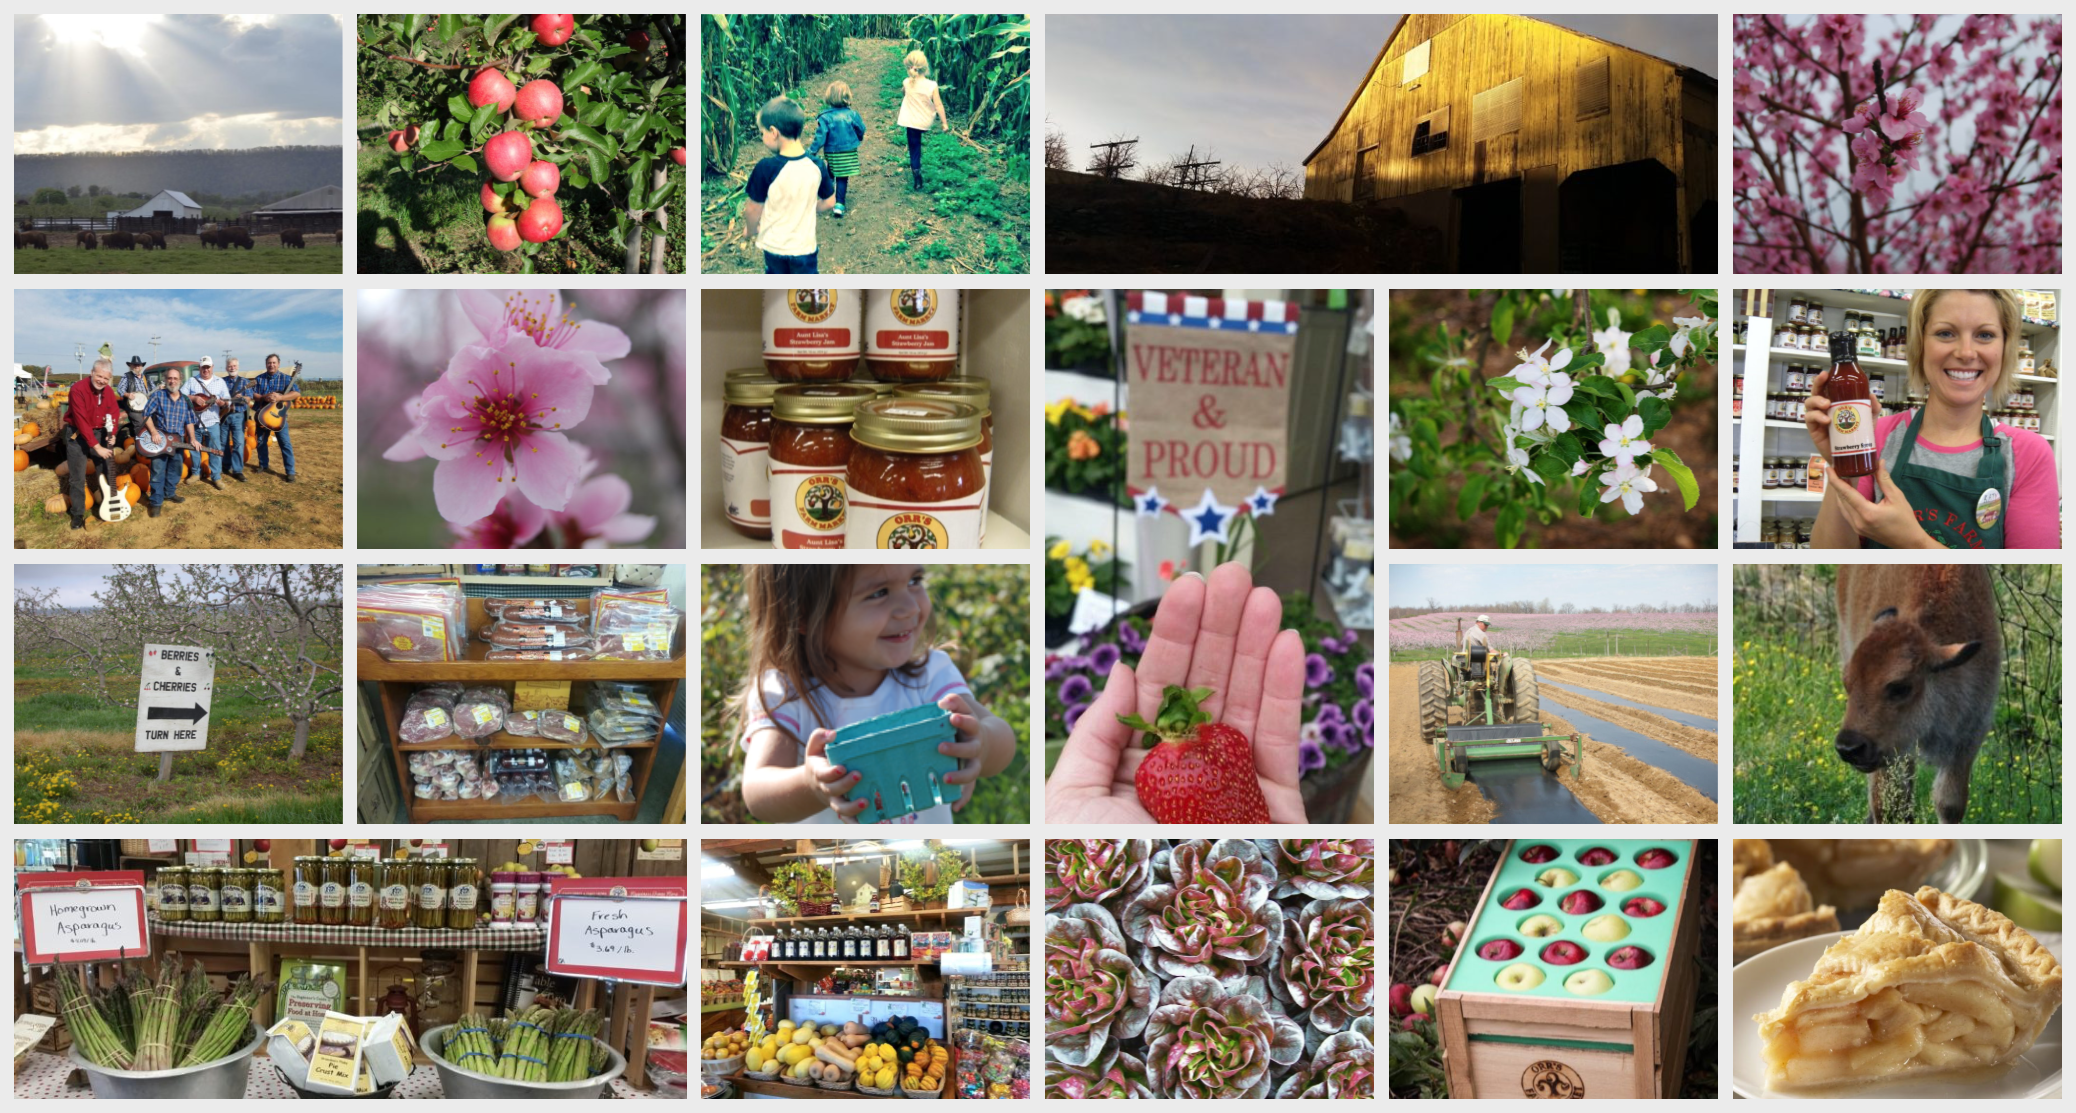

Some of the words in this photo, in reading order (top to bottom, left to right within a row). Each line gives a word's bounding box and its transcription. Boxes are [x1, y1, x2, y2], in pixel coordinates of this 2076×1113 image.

[1133, 344, 1289, 389] VETERAN
[1192, 394, 1228, 430] &
[1142, 440, 1277, 480] PROUD
[808, 476, 839, 485] ORR'S
[799, 507, 817, 528] FARM
[894, 514, 932, 526] ORR'S
[161, 650, 199, 661] BERRIES
[175, 666, 181, 676] &
[153, 681, 197, 692] CHERRIES
[145, 730, 169, 740] TURN
[173, 730, 197, 740] HERE
[50, 903, 116, 919] Homegrown
[591, 909, 628, 921] Fresh
[57, 921, 122, 937] Asparagus
[584, 925, 654, 939] Asparagus
[289, 998, 332, 1010] Preserving
[287, 1008, 303, 1016] Food
[315, 1067, 334, 1075] Crust
[1531, 1062, 1562, 1073] ORR'S
